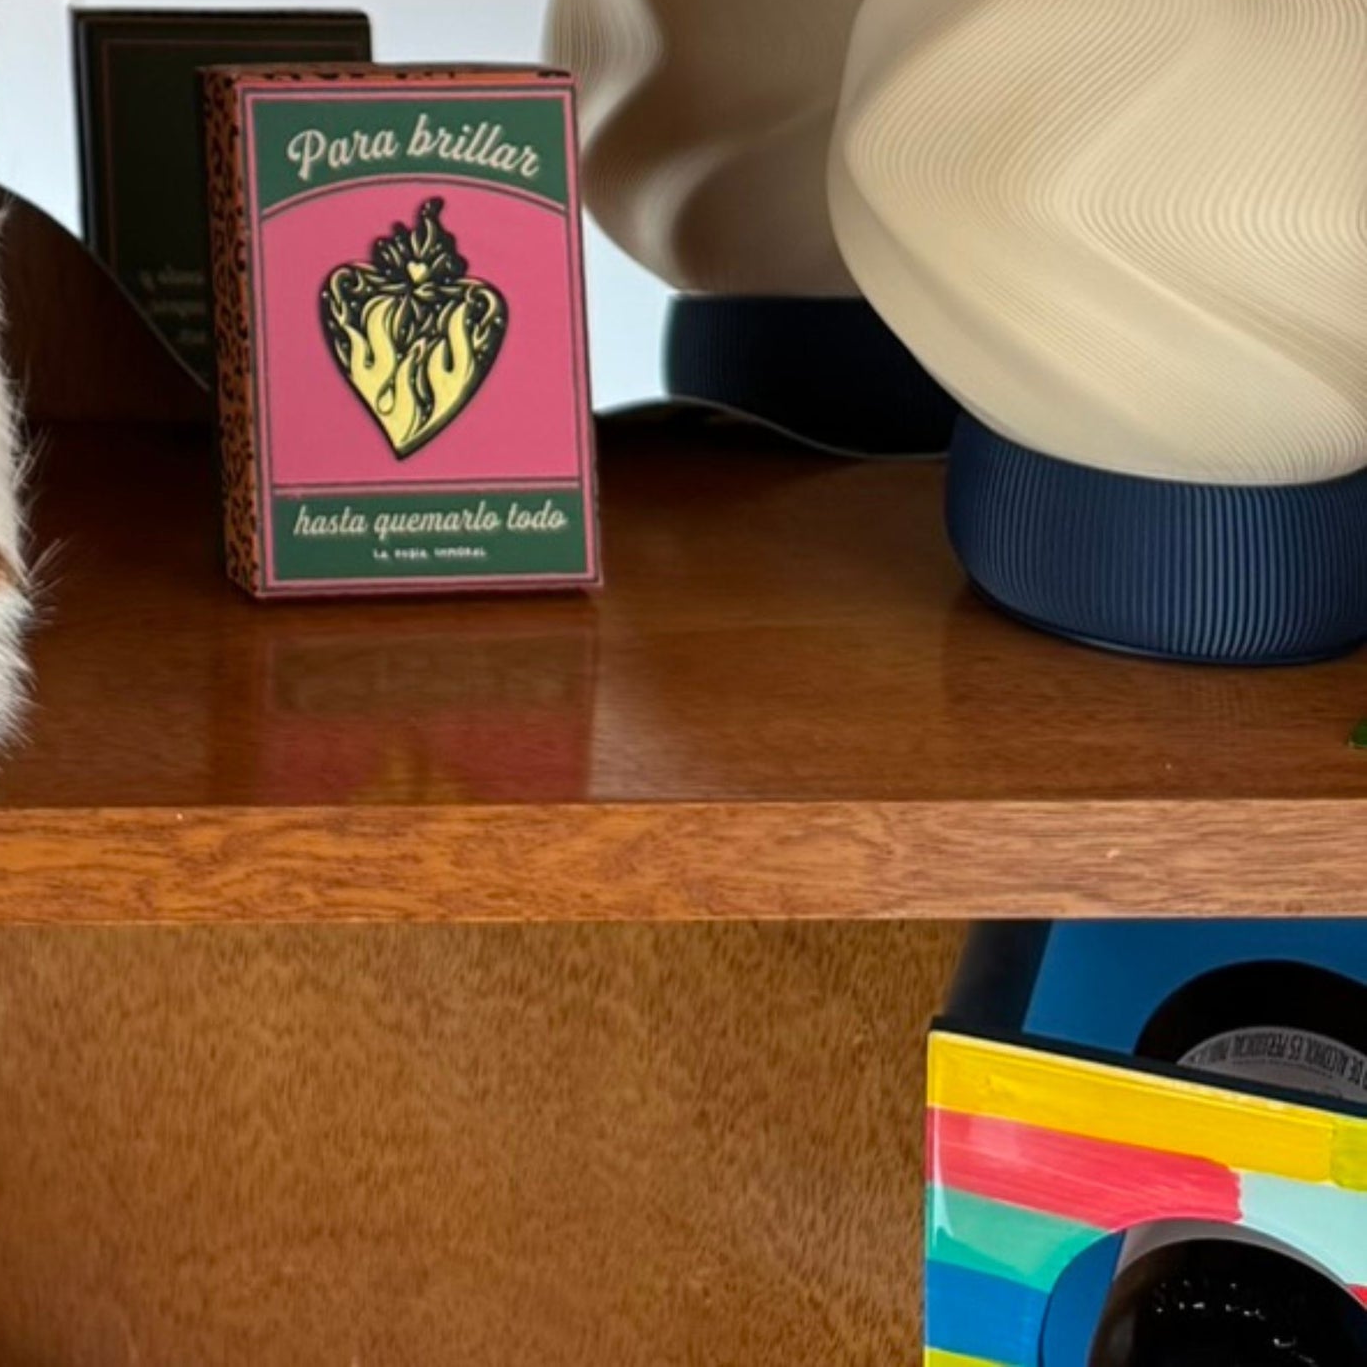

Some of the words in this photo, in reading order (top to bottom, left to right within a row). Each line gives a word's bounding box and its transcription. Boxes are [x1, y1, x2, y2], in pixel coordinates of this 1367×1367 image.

[286, 127, 400, 180] Para
[406, 113, 541, 179] brillar
[293, 504, 368, 537] hasta
[373, 501, 503, 539] quemarlo
[506, 499, 567, 532] todo
